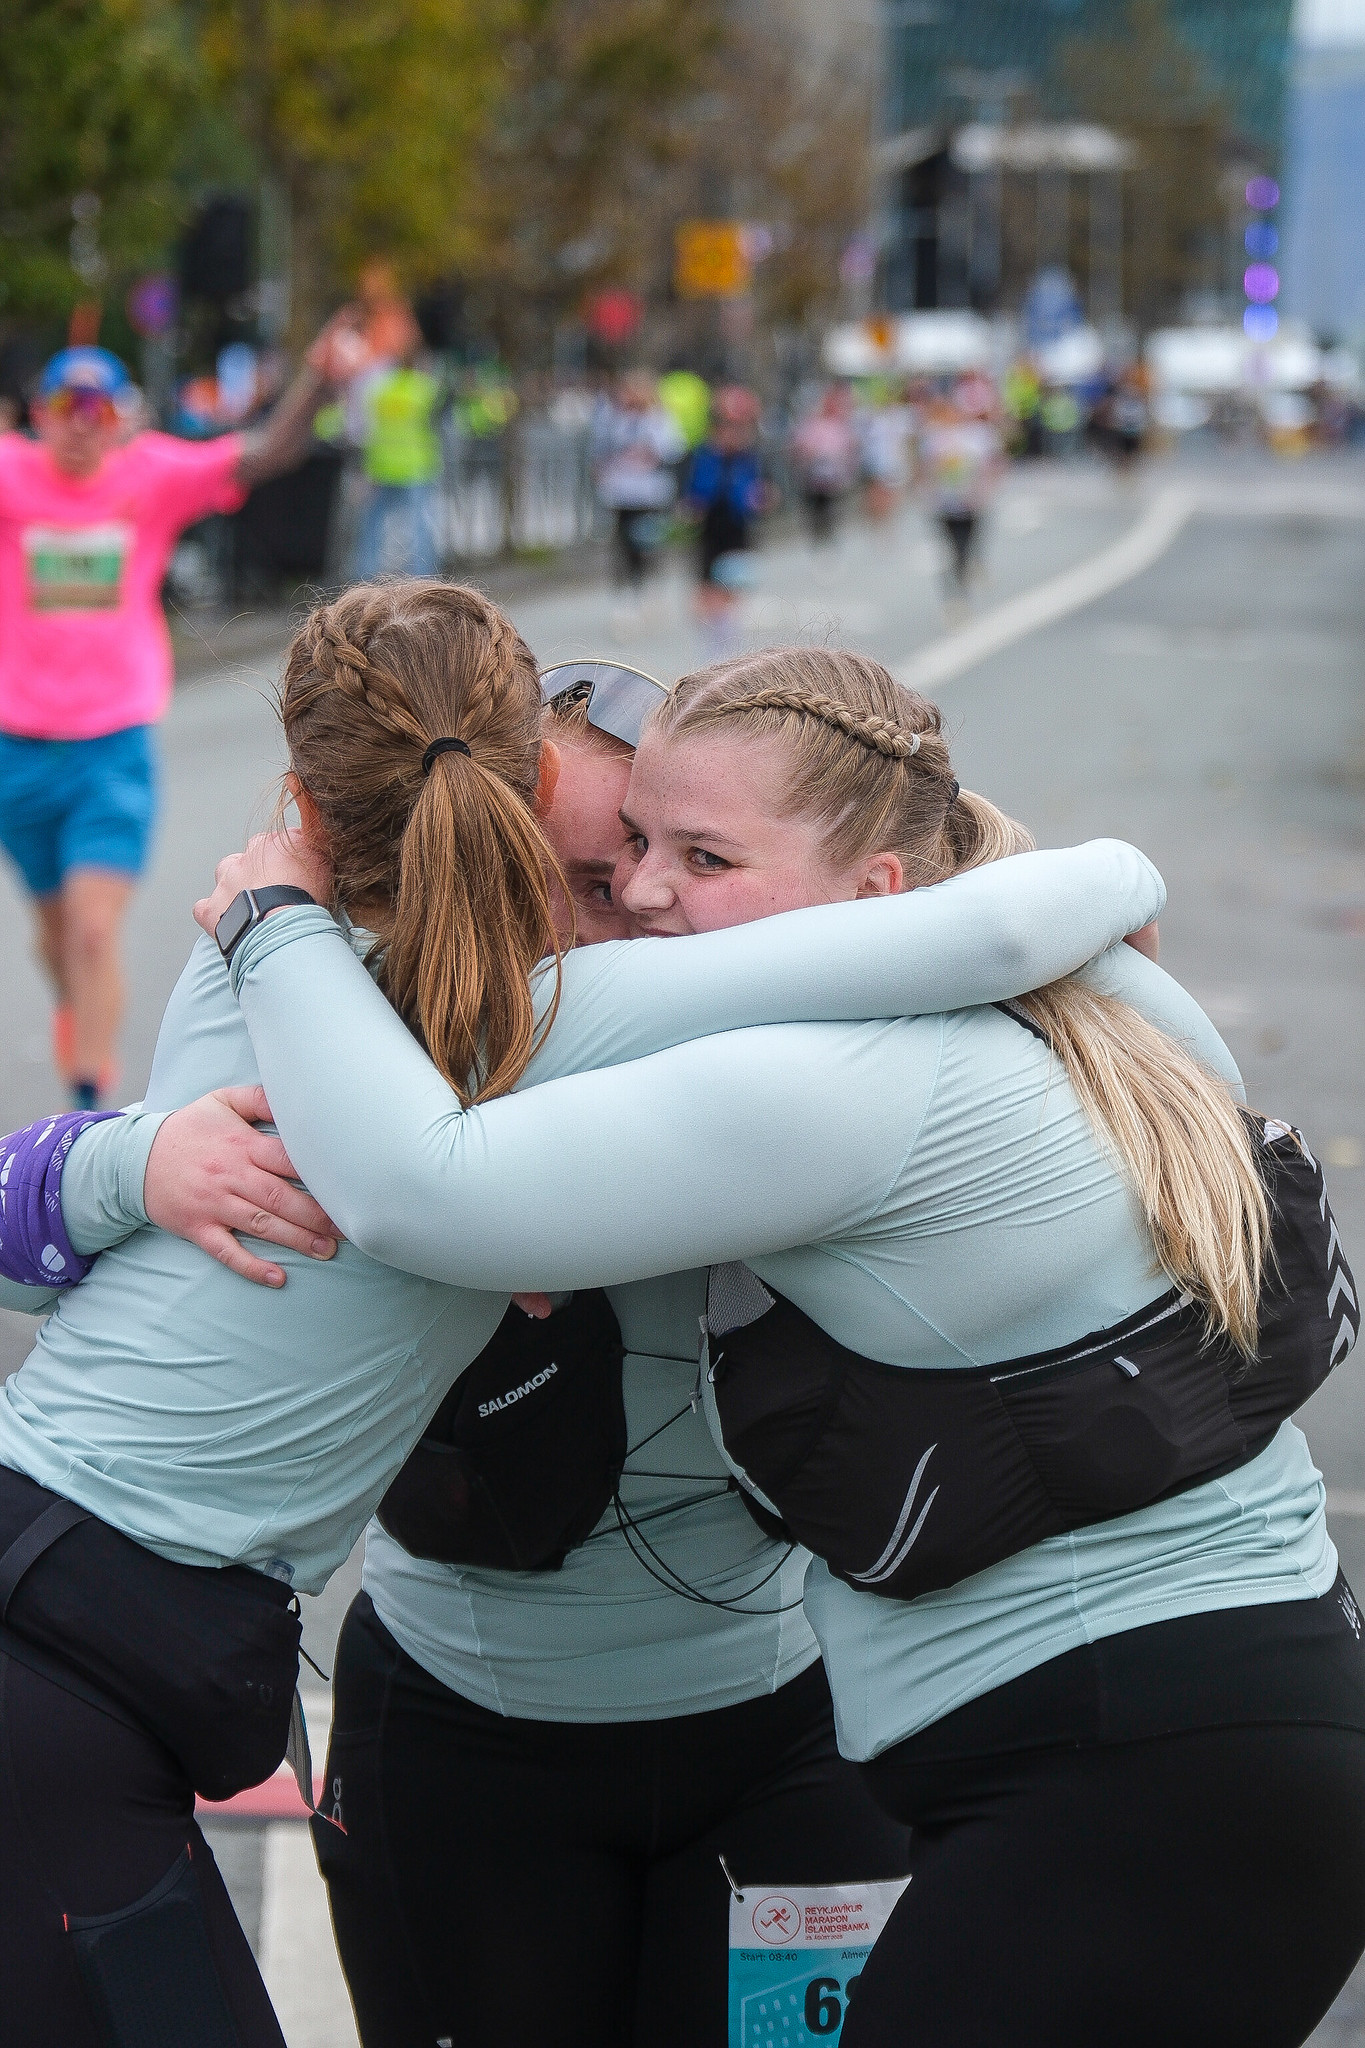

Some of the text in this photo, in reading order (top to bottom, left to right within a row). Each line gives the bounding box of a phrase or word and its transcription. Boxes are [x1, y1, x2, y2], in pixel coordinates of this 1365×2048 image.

[477, 1362, 559, 1418] SALOMON
[805, 1903, 863, 1915] REYKJAVÍKUR
[805, 1922, 870, 1934] ÍSLANDSBANKA
[740, 1952, 798, 1962] Start: 08:40
